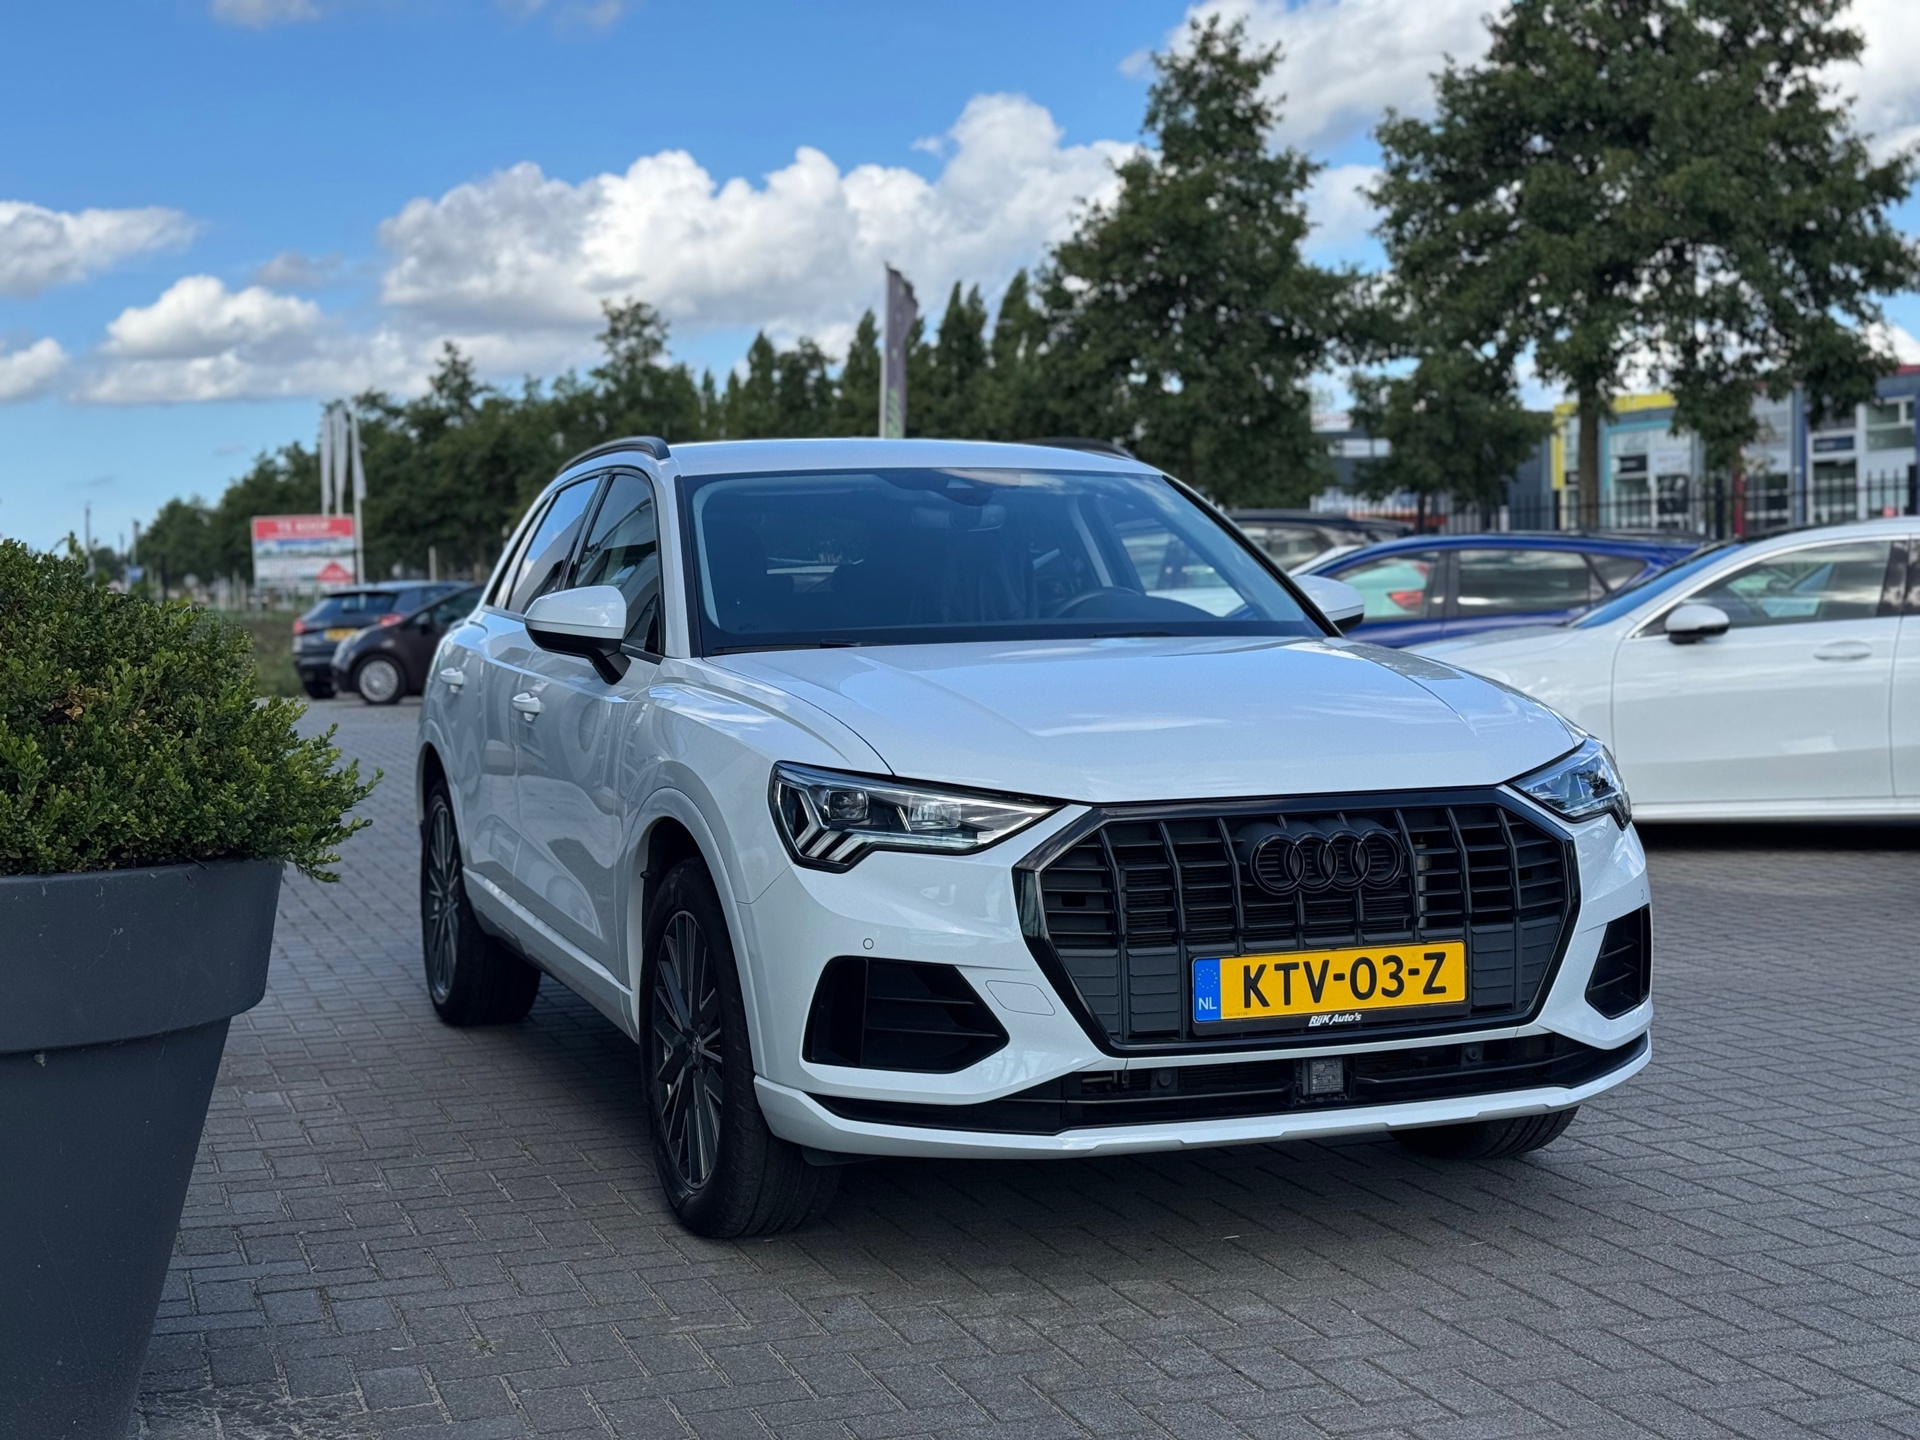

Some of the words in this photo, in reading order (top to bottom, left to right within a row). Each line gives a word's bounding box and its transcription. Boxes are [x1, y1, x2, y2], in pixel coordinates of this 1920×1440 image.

[1243, 951, 1447, 1009] KTV-03-Z
[1198, 997, 1218, 1011] NL
[1329, 1012, 1362, 1025] Auto's
